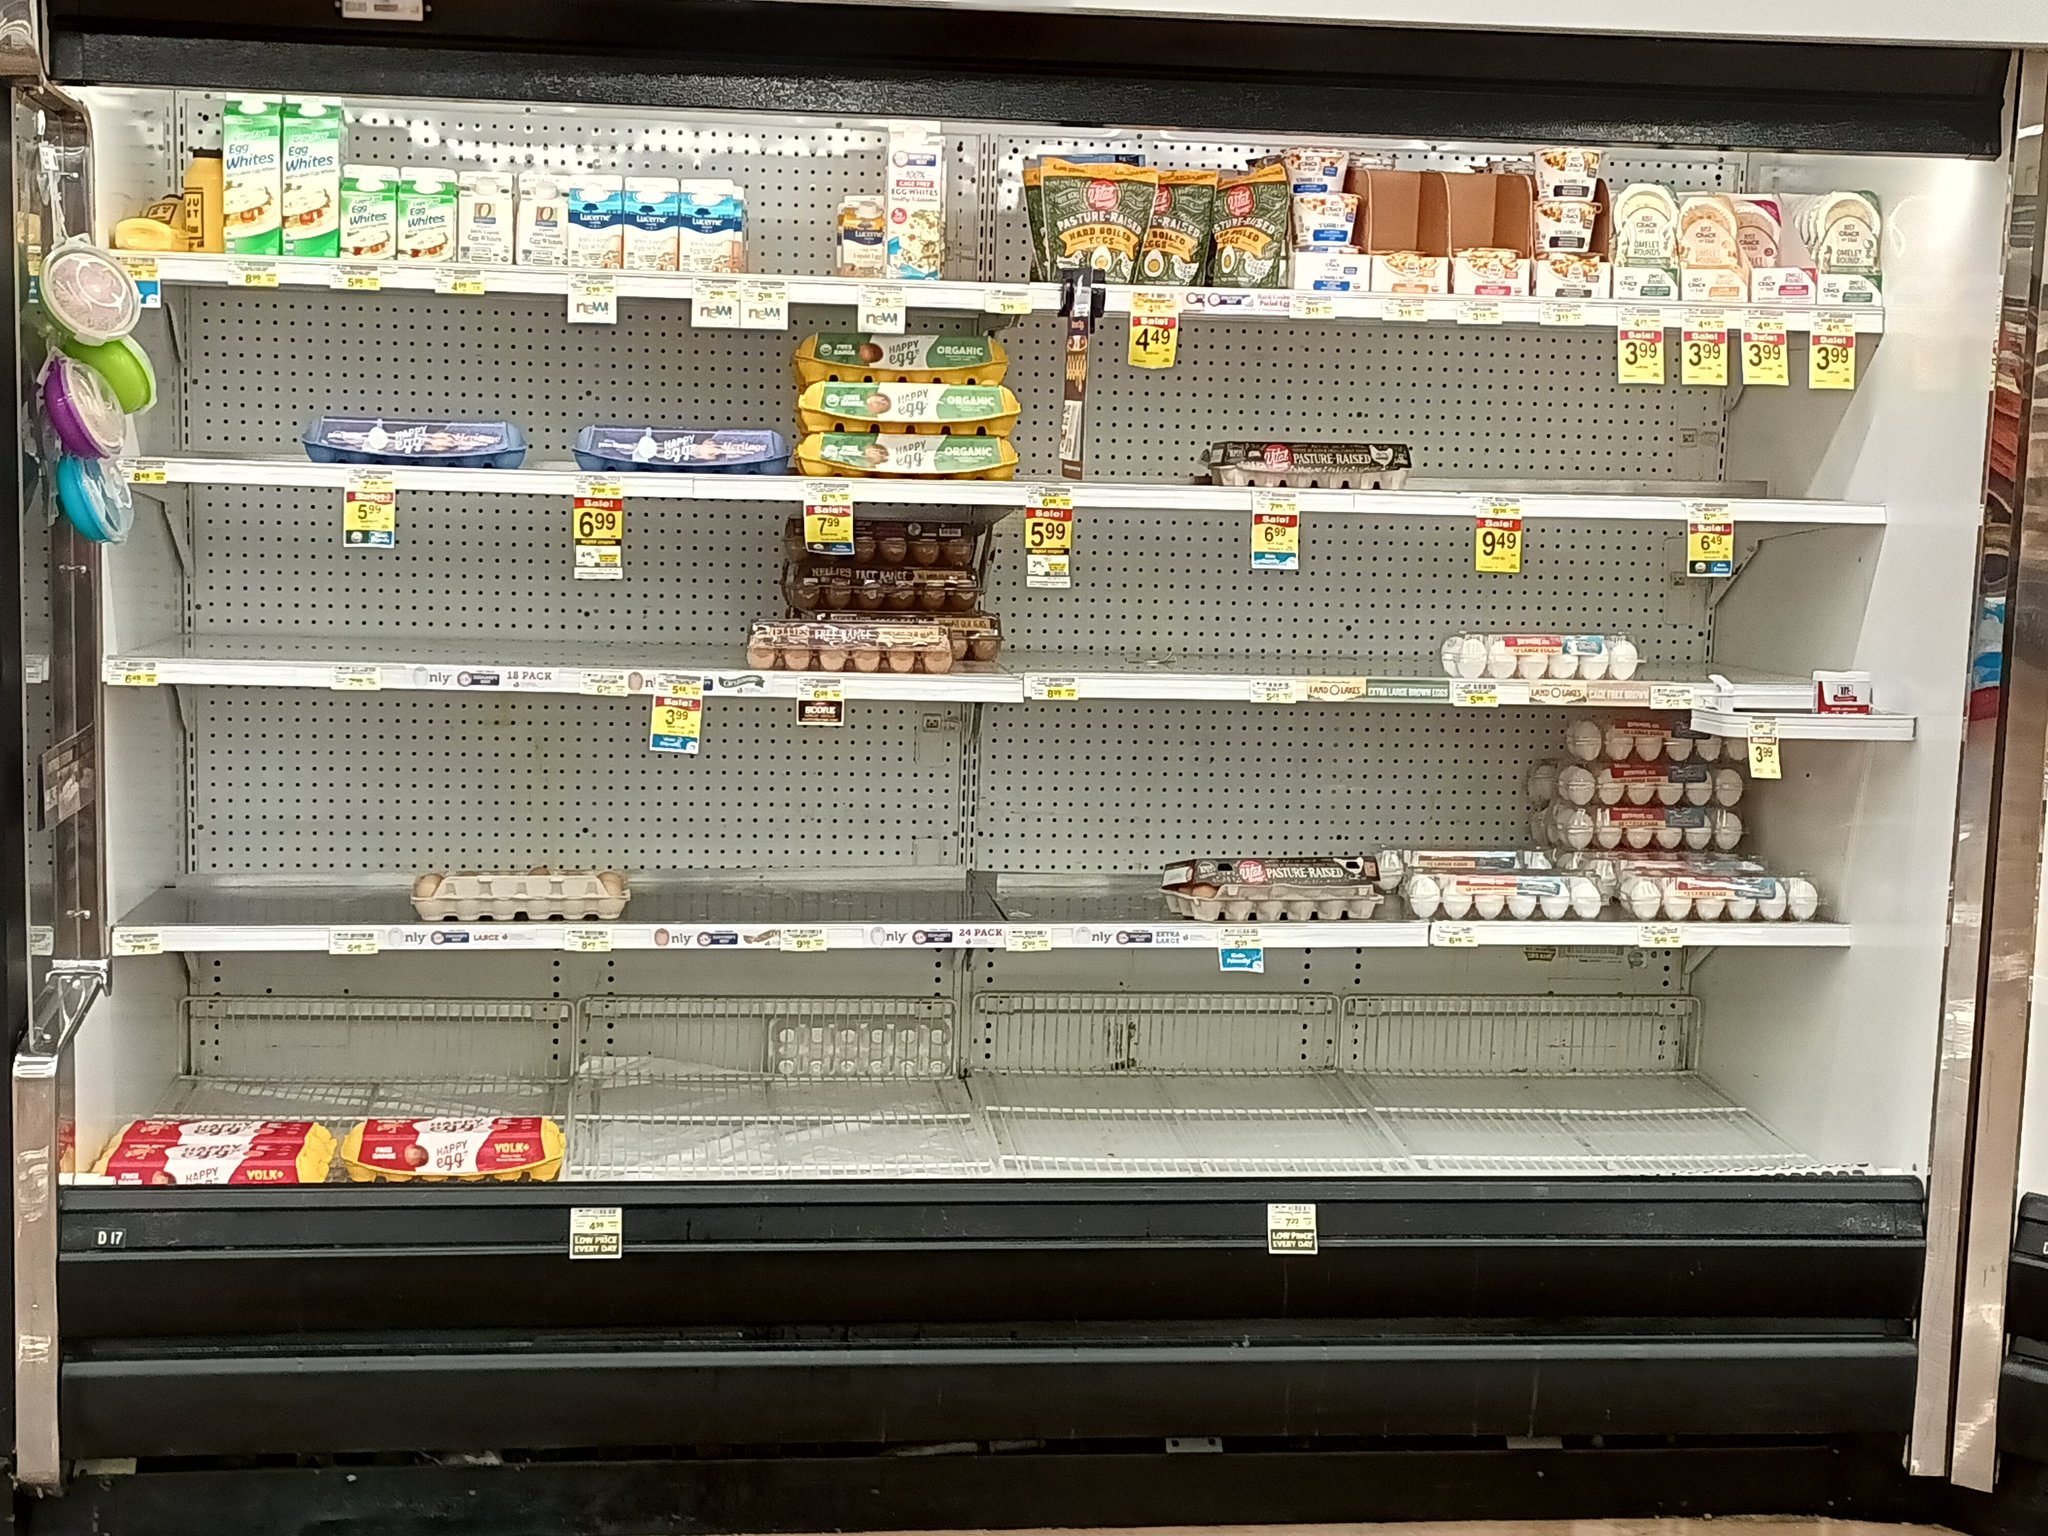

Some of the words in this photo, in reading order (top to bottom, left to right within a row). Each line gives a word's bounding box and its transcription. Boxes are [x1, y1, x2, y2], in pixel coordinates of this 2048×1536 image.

[229, 144, 249, 155] Egg
[288, 146, 308, 157] Egg
[226, 153, 274, 170] Whites
[285, 155, 334, 172] Whites
[351, 205, 367, 213] Egg
[410, 207, 426, 215] Egg
[350, 213, 387, 226] Whites
[408, 214, 445, 227] Whites
[1056, 211, 1142, 234] PASTURE-RAISED
[1069, 227, 1096, 241] HARD
[1099, 226, 1132, 243] BOILED
[1140, 317, 1169, 326] Sale!
[889, 339, 919, 354] HAPPY
[937, 345, 983, 356] ORGANIC
[889, 352, 917, 367] egg
[898, 389, 929, 404] HAPPY
[947, 395, 995, 406] ORGANIC
[898, 402, 927, 417] egg
[664, 434, 695, 449] HAPPY
[895, 440, 927, 455] HAPPY
[944, 446, 993, 457] ORGANIC
[895, 453, 924, 468] egg
[1293, 453, 1371, 465] PASTURE-RAISED
[584, 499, 614, 508] Sale!
[1035, 509, 1064, 518] Sale!
[1262, 515, 1289, 524] Sale!
[1485, 519, 1513, 528] Sale!
[507, 671, 519, 680] 18
[522, 671, 552, 681] PACK
[1340, 686, 1361, 695] LAKES
[1368, 688, 1388, 697] EXTRA
[1389, 688, 1408, 697] LARGE
[1409, 688, 1432, 698] BROWN
[1562, 689, 1582, 698] LAKES
[663, 698, 693, 707] Sale!
[1266, 867, 1344, 879] PASTURE-RAISED
[473, 934, 499, 942] LARGE
[959, 929, 971, 937] 24
[974, 929, 1003, 937] PACK
[436, 1140, 468, 1156] HAPPY
[436, 1152, 465, 1171] egg
[186, 1167, 219, 1183] HAPPY
[97, 1231, 107, 1245] D
[110, 1231, 123, 1245] 17
[574, 1236, 593, 1245] LOW
[594, 1236, 618, 1244] PRICE
[1291, 1232, 1314, 1240] PRICE
[574, 1245, 599, 1253] EVERY
[600, 1244, 618, 1253] DAY
